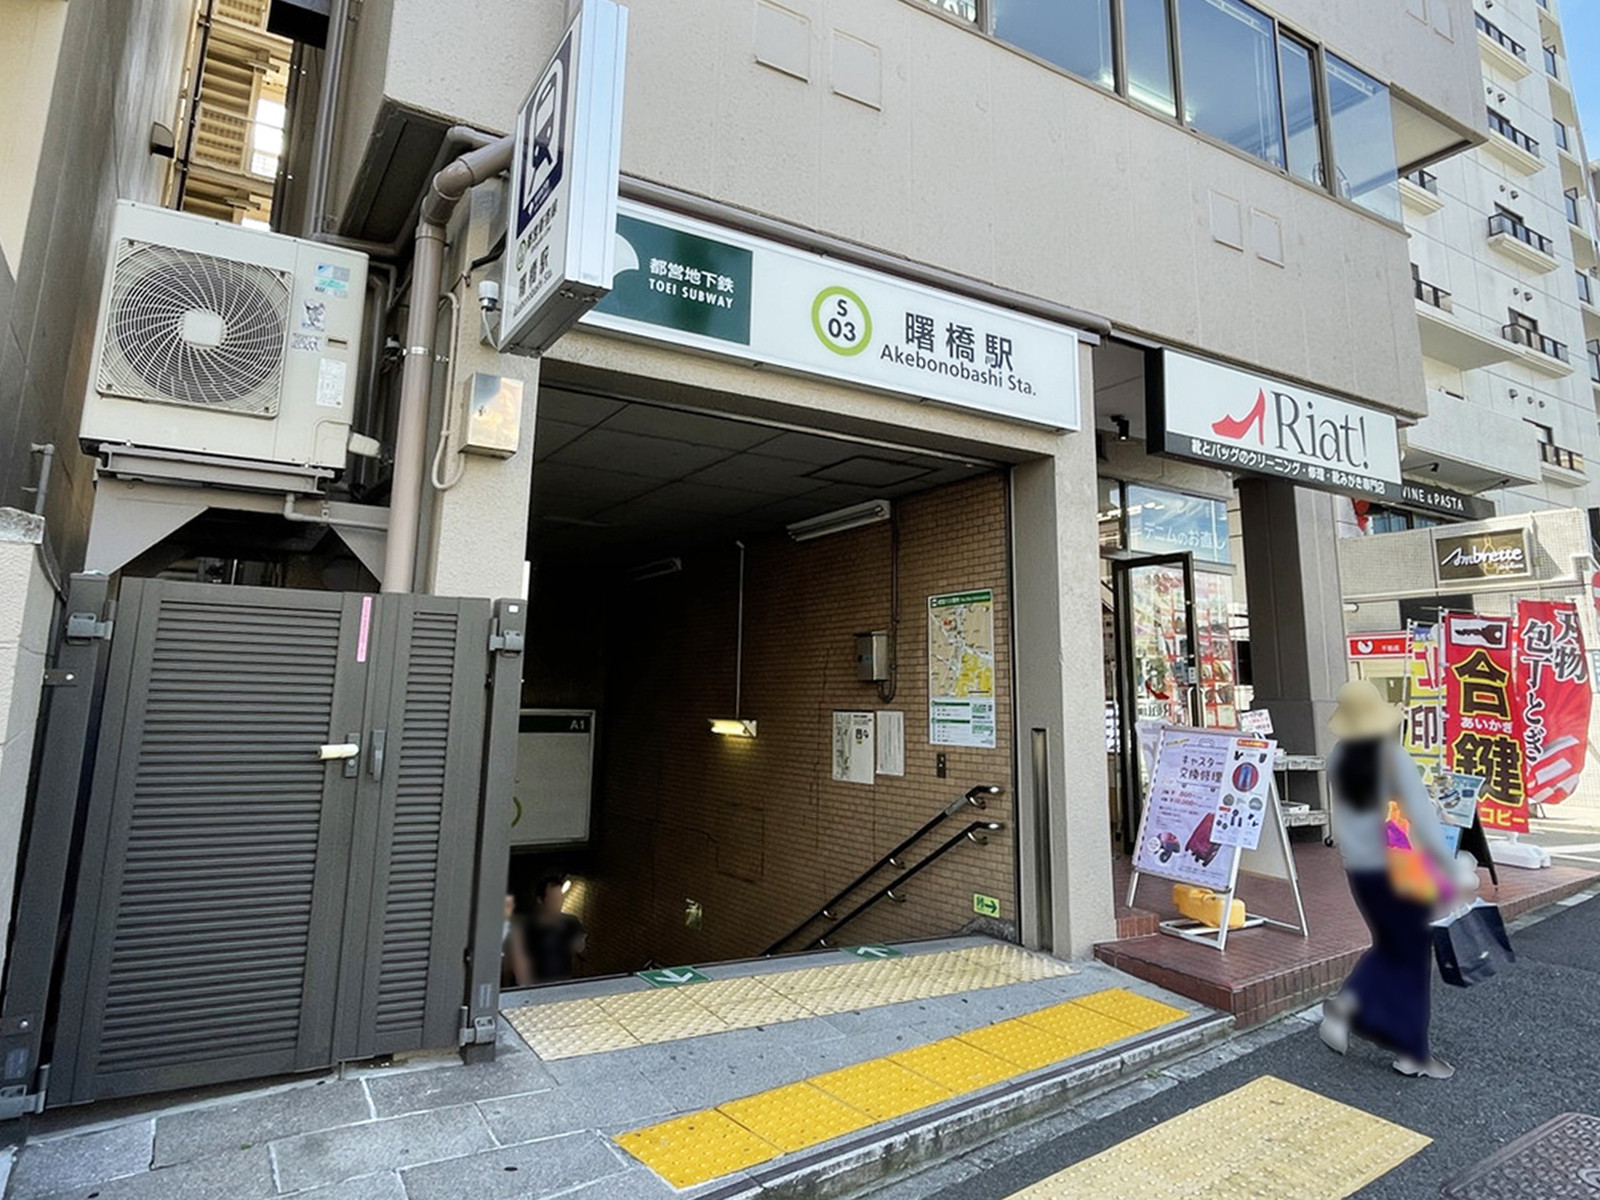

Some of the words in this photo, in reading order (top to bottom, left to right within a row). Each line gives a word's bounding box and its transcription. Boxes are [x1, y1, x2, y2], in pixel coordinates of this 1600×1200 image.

[649, 257, 734, 293] 都営地下鉄
[648, 278, 677, 295] TOEI
[682, 286, 733, 309] SUBWAY
[837, 299, 848, 317] S
[828, 317, 857, 342] 03
[905, 311, 1014, 372] 曙橋駅
[880, 344, 1003, 388] Akebonobashi
[1008, 374, 1037, 396] Sta.
[1270, 390, 1369, 470] Riat!
[1434, 492, 1465, 512] PASTA
[569, 719, 585, 730] A1
[1460, 716, 1513, 734] あいかぎ
[1182, 755, 1223, 768] キャスター
[1180, 767, 1222, 782] 交換修理
